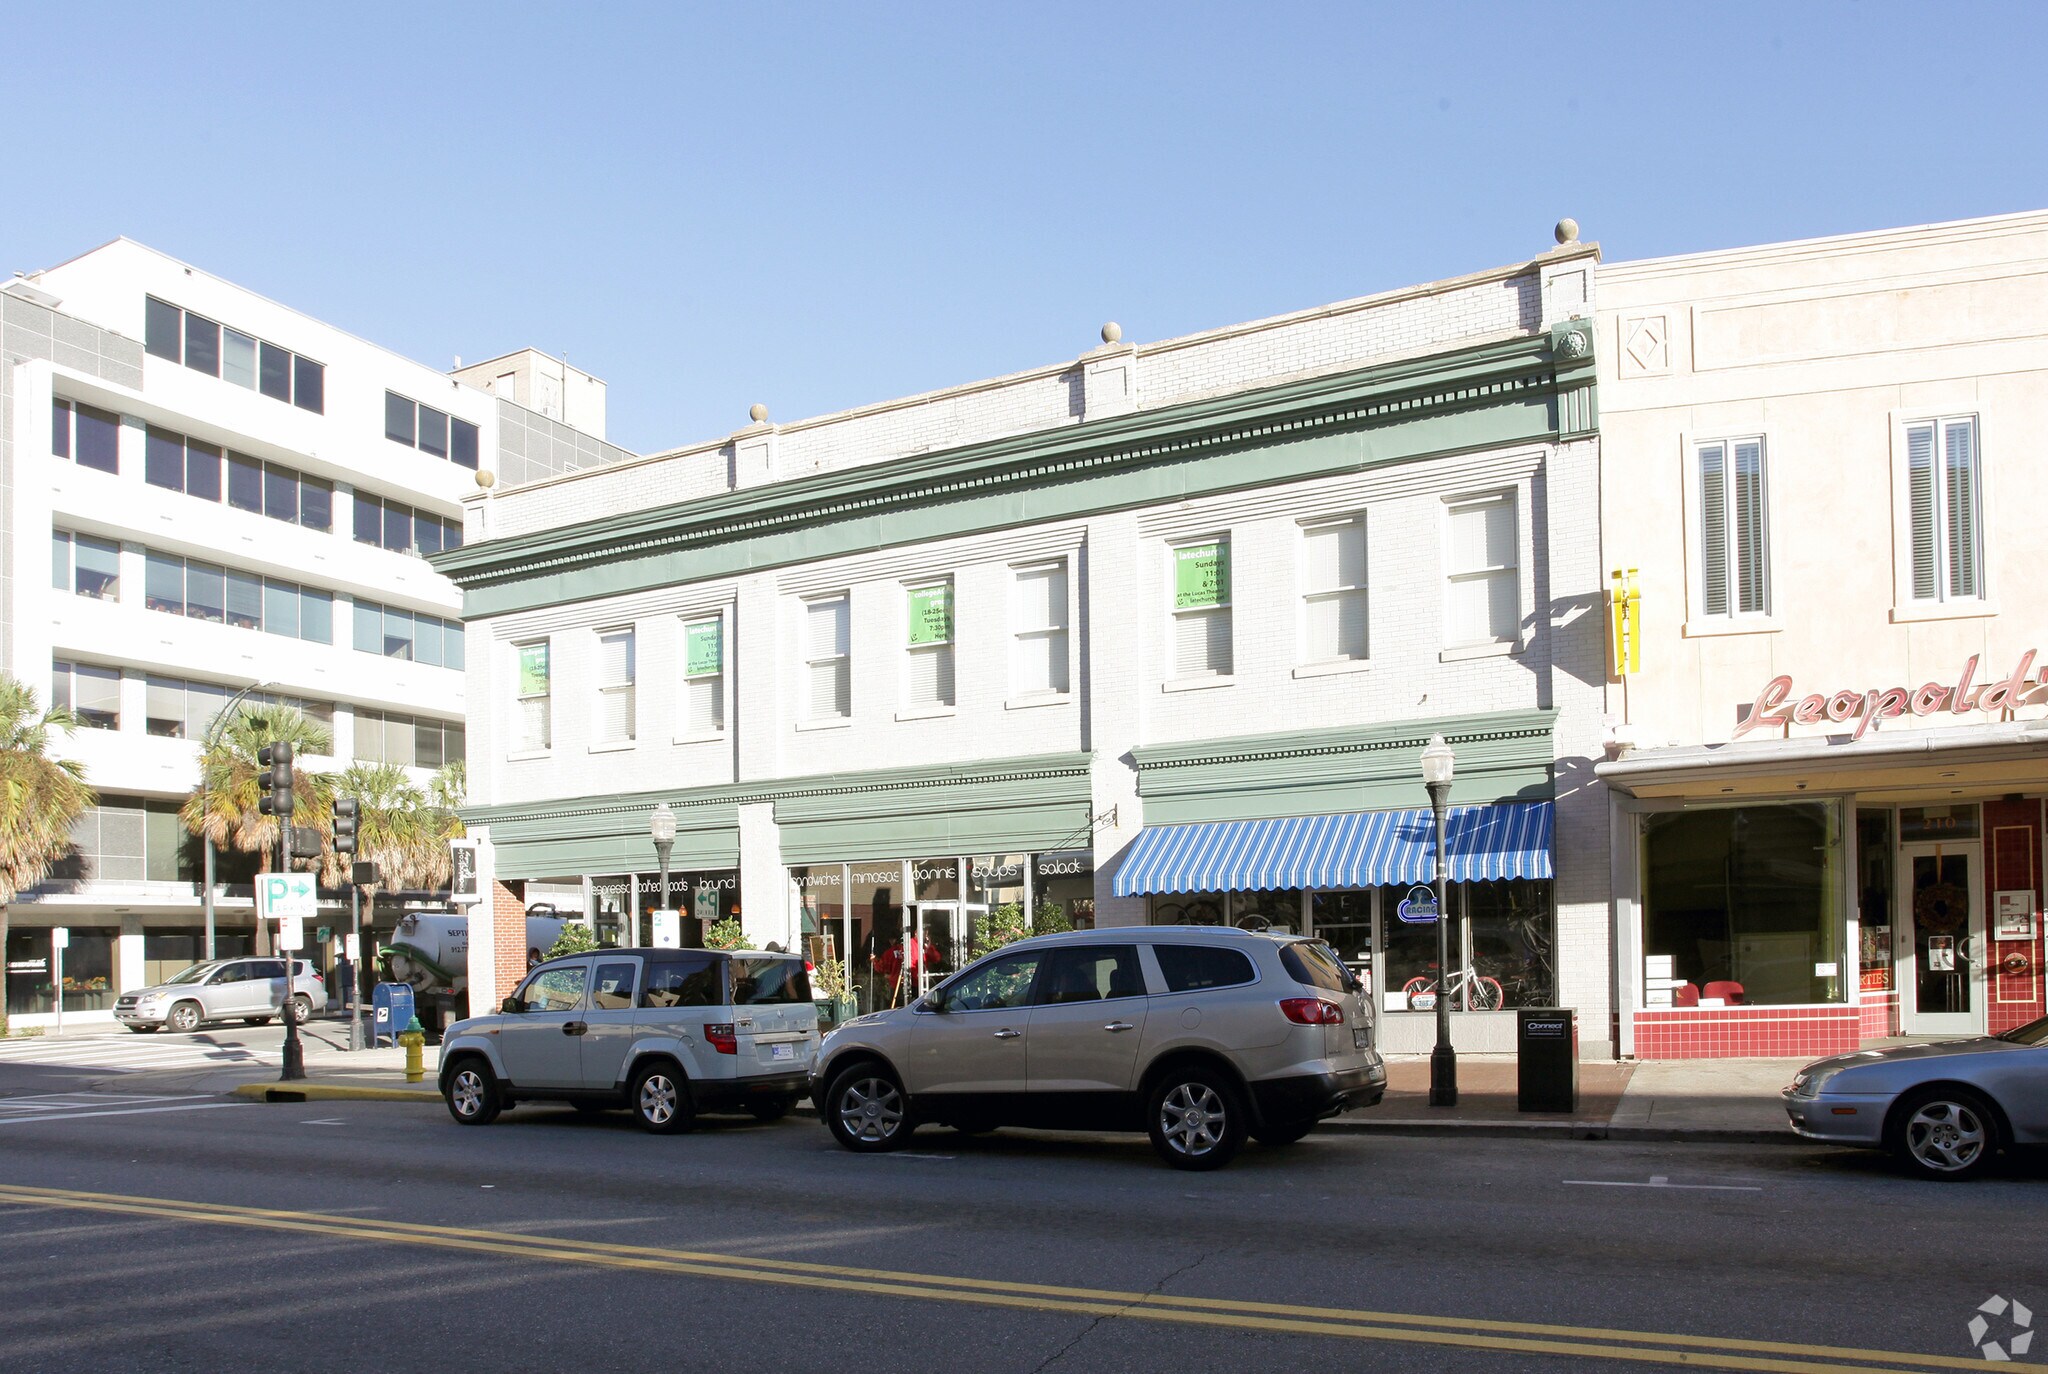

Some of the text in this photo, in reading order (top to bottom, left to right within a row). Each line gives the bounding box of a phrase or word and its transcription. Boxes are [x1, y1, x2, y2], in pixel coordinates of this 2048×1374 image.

[1179, 547, 1225, 560] latechurch
[1195, 560, 1224, 569] Sundays
[1205, 569, 1224, 577] 11:01
[1923, 817, 1957, 830] 210
[972, 864, 1018, 880] soups
[1039, 858, 1084, 876] salads
[852, 871, 899, 884] mimosas
[912, 865, 956, 884] paninis
[1406, 906, 1437, 914] RACING
[1527, 1022, 1563, 1030] Connect
